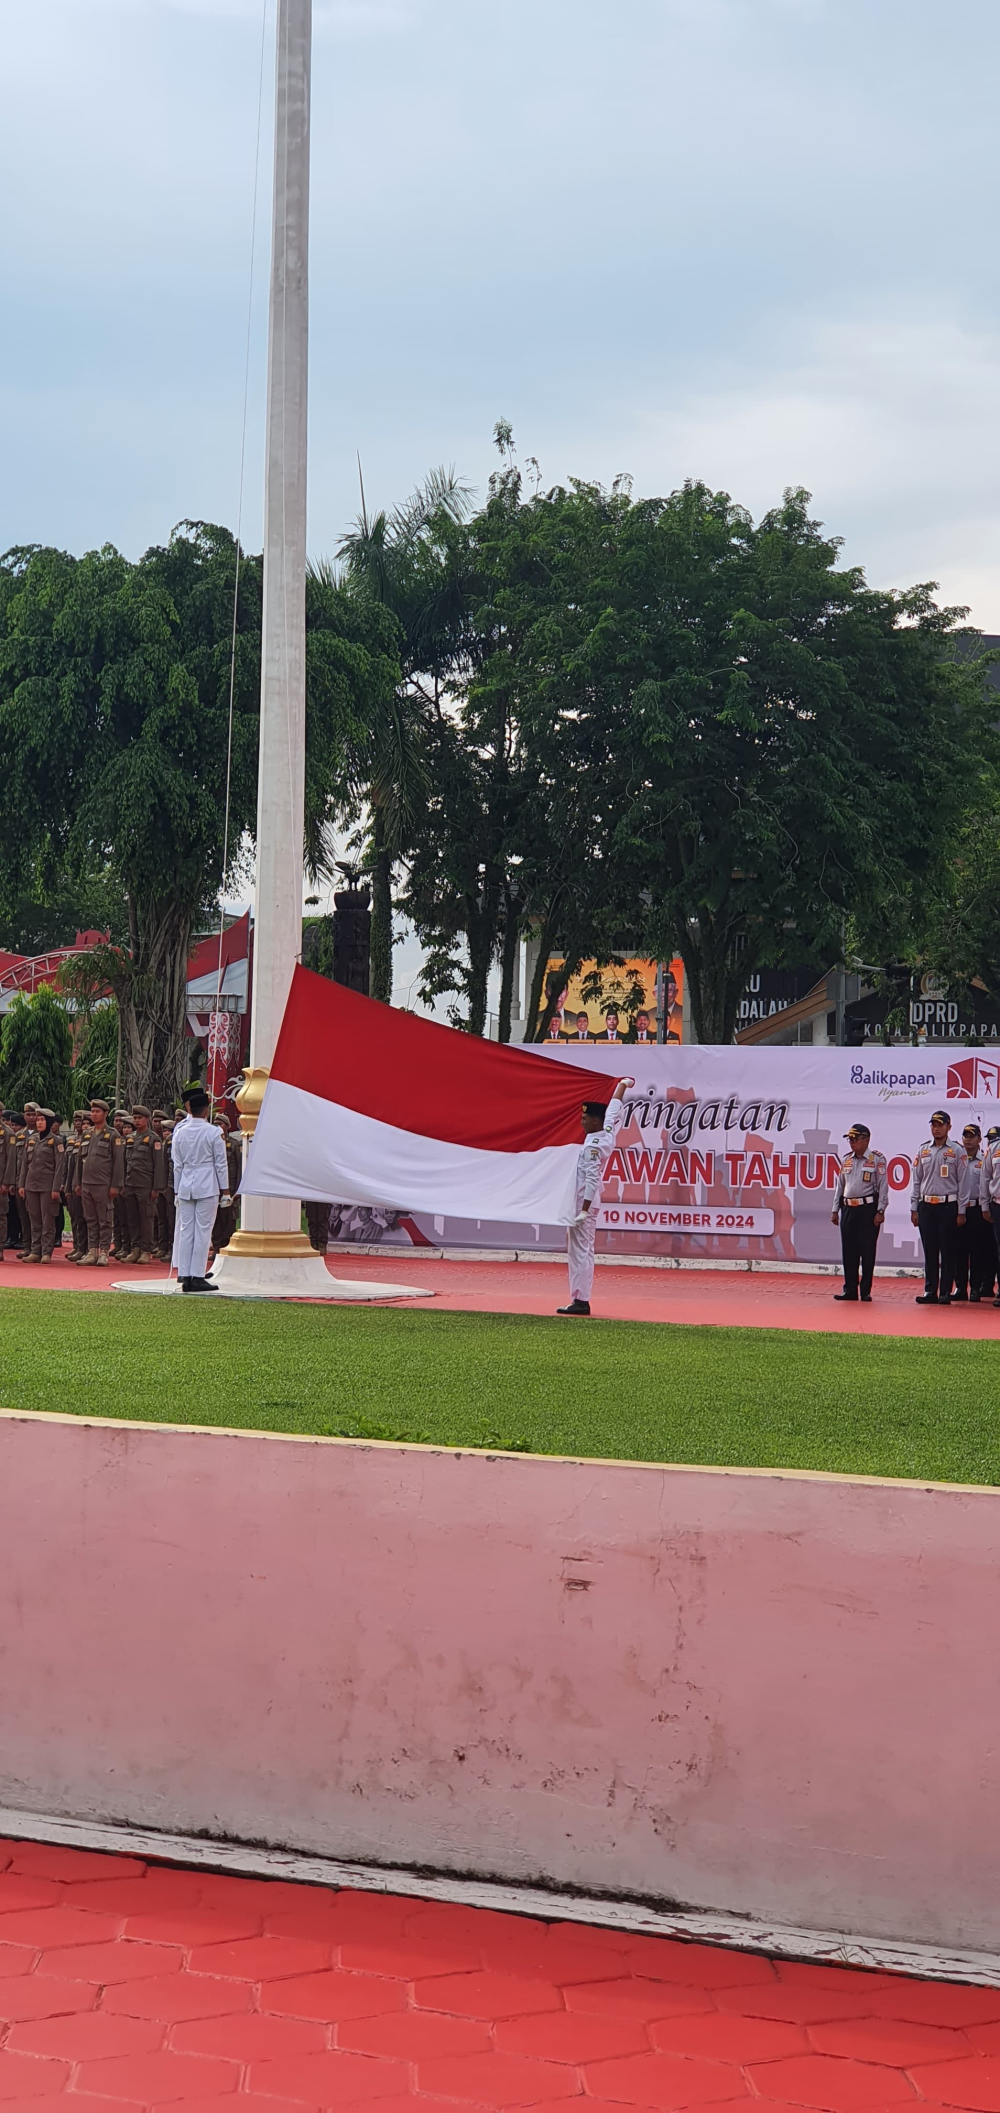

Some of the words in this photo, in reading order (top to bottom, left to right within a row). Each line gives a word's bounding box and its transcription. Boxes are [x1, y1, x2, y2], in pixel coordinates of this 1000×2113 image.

[913, 1002, 958, 1023] DPRD
[910, 1023, 998, 1037] ALIKPAPA
[850, 1064, 936, 1088] Balikpapan
[614, 1089, 789, 1145] ringatan
[602, 1149, 714, 1185] AWAN
[603, 1210, 620, 1223] 10
[624, 1211, 712, 1226] NOVEMBER
[716, 1214, 755, 1228] 2024
